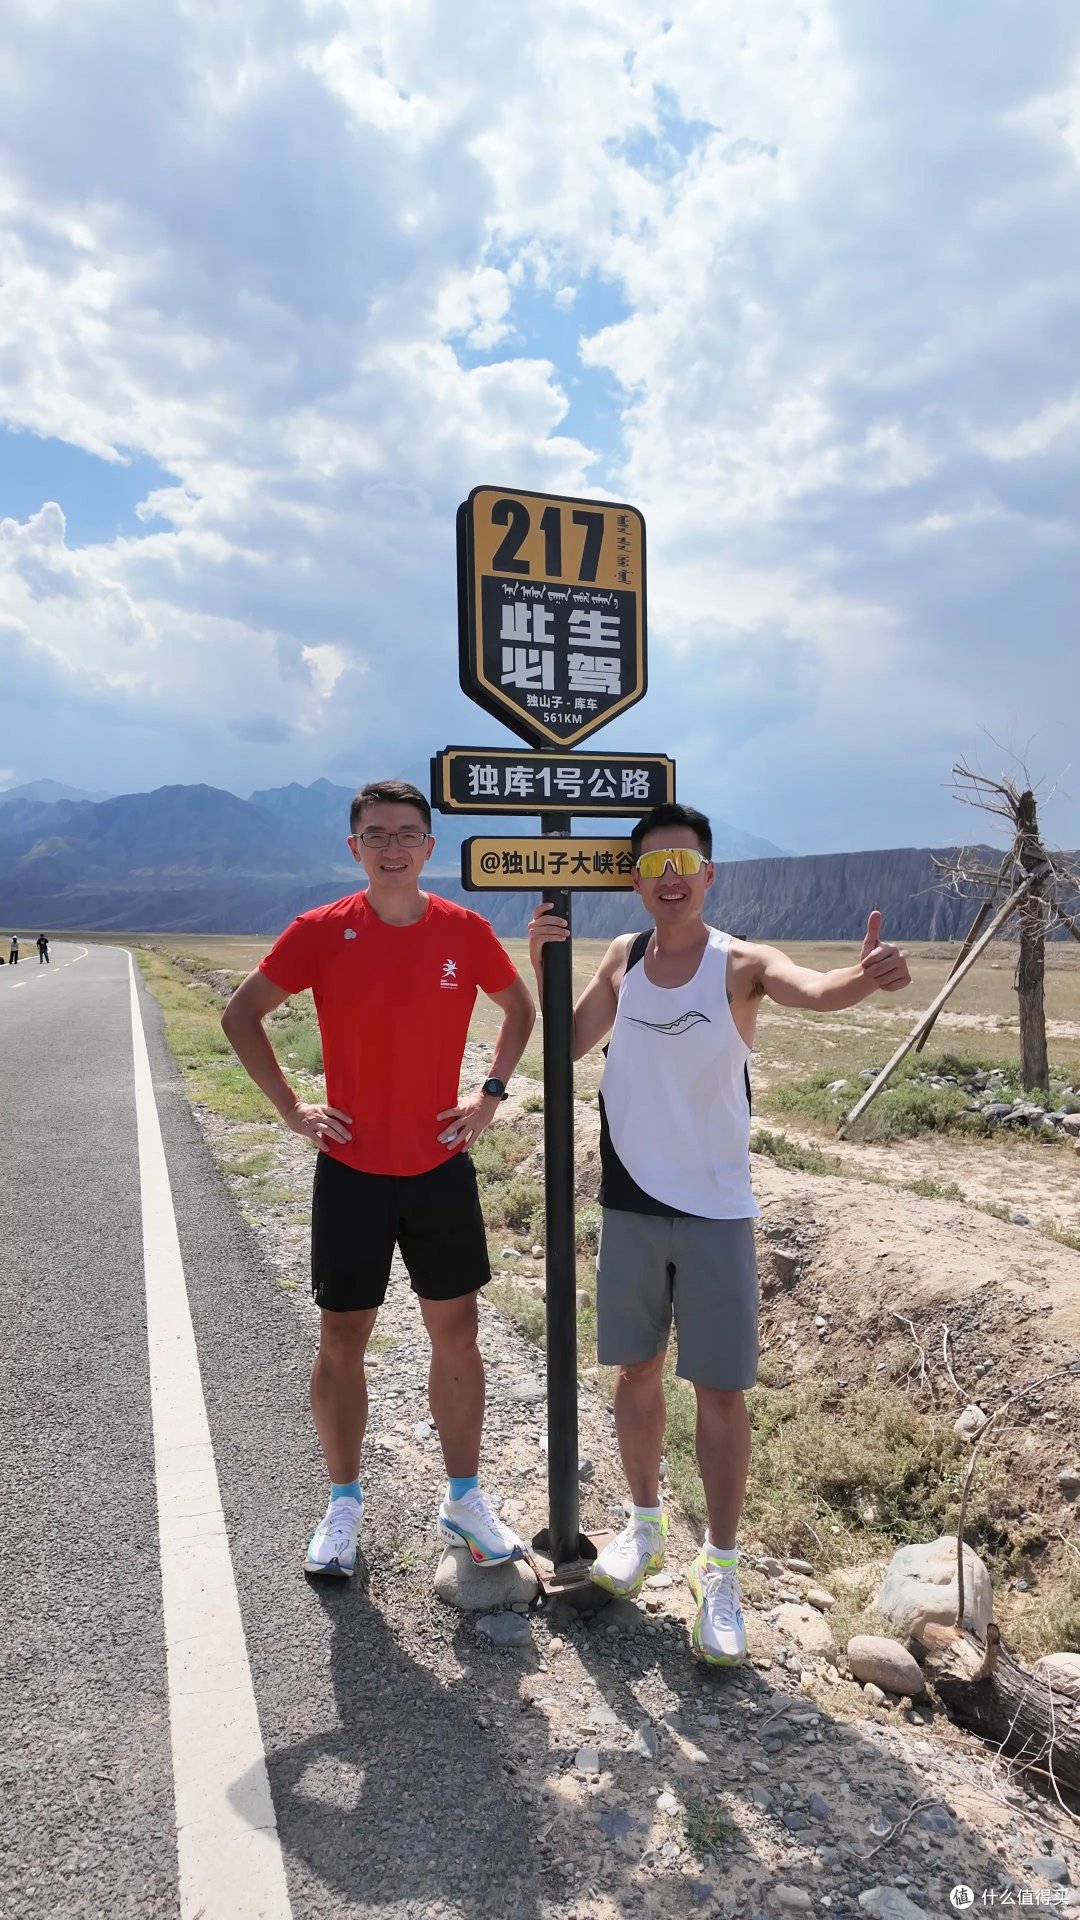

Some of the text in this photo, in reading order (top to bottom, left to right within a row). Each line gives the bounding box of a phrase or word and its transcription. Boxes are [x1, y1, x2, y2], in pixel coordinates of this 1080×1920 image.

[491, 498, 605, 583] 217
[500, 601, 621, 650] 此生
[500, 646, 622, 695] 必驾
[543, 712, 582, 724] 561KM
[468, 763, 651, 799] 独库1号公路
[480, 850, 633, 876] @独山子大峡谷
